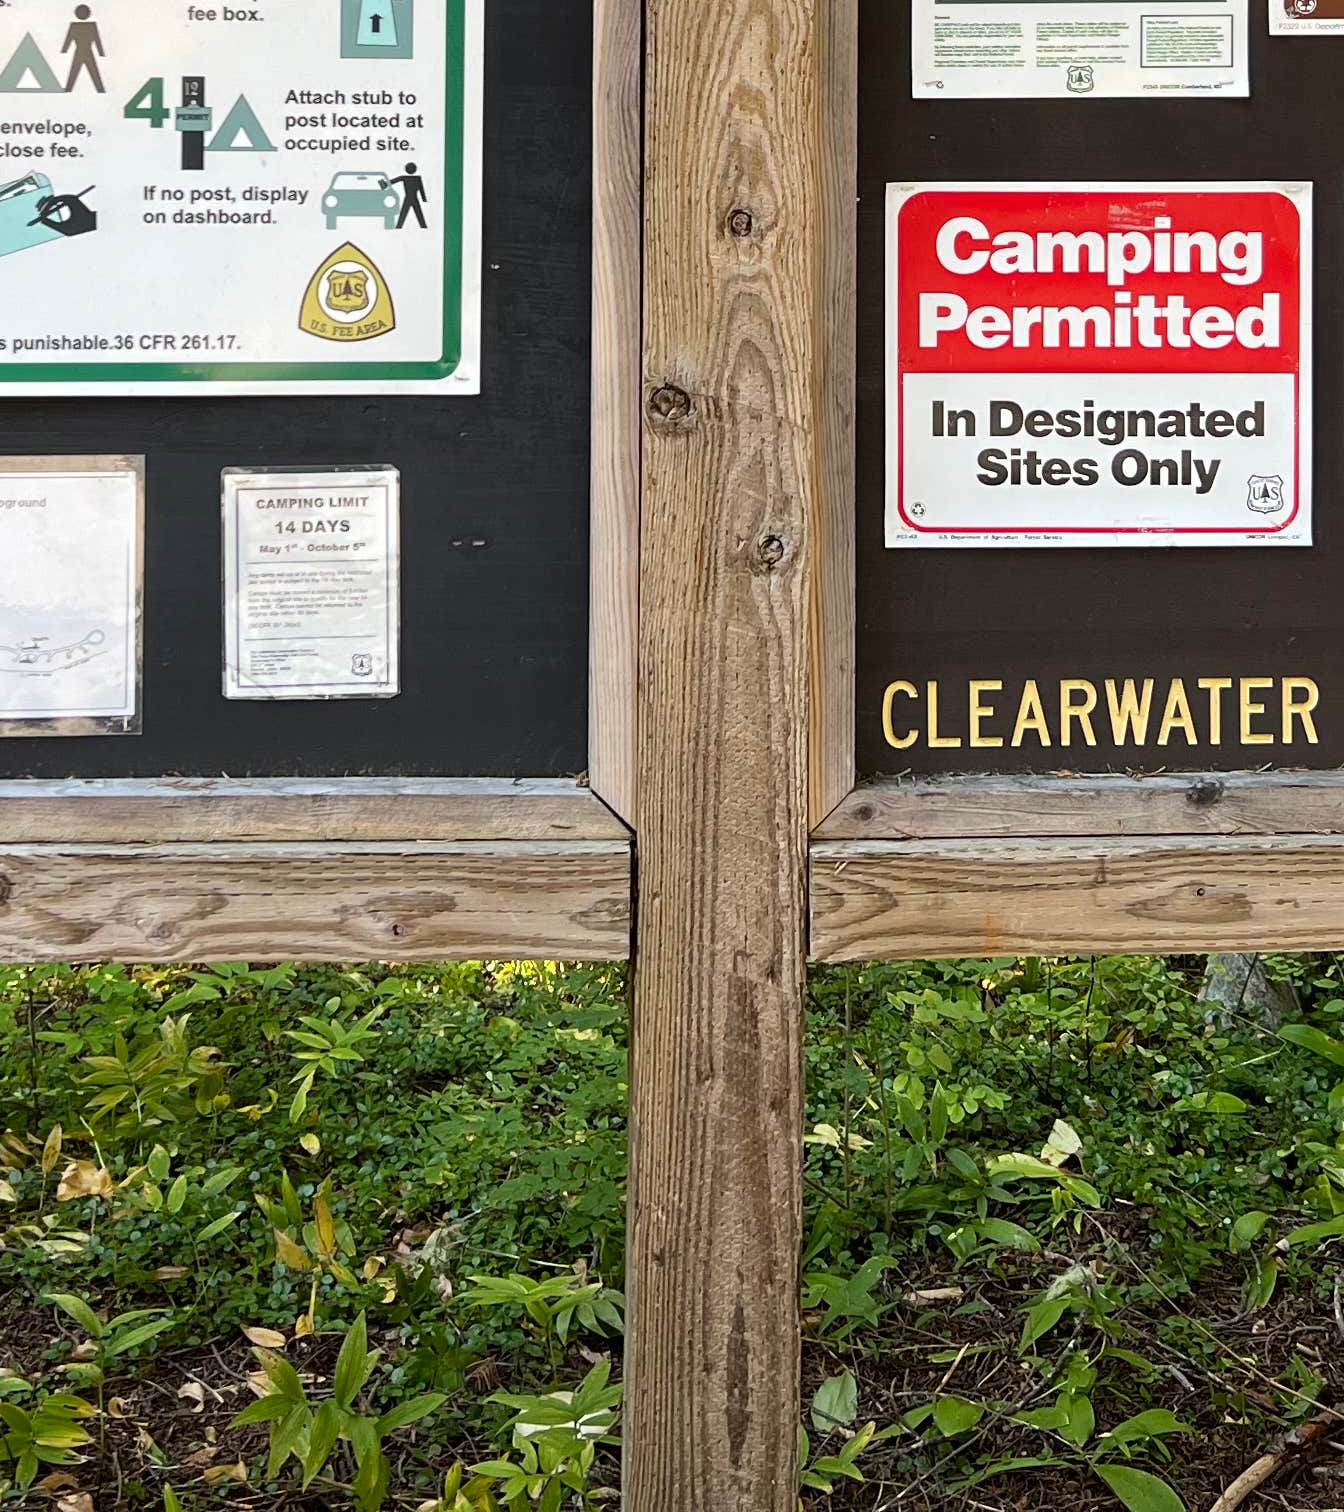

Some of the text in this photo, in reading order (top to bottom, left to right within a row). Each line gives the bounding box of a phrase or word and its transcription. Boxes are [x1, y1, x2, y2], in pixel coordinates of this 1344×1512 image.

[187, 5, 264, 22] fee box.
[936, 217, 1262, 285] Camping
[139, 334, 177, 350] CFR
[181, 334, 241, 350] 261.17.
[919, 291, 1280, 349] Permitted
[932, 399, 1265, 446] In Designated
[976, 447, 1222, 495] Sites Only
[255, 496, 369, 510] CAMPING LIMIT
[274, 519, 351, 535] 14 DAYS
[883, 678, 1319, 748] CLEARWATER
